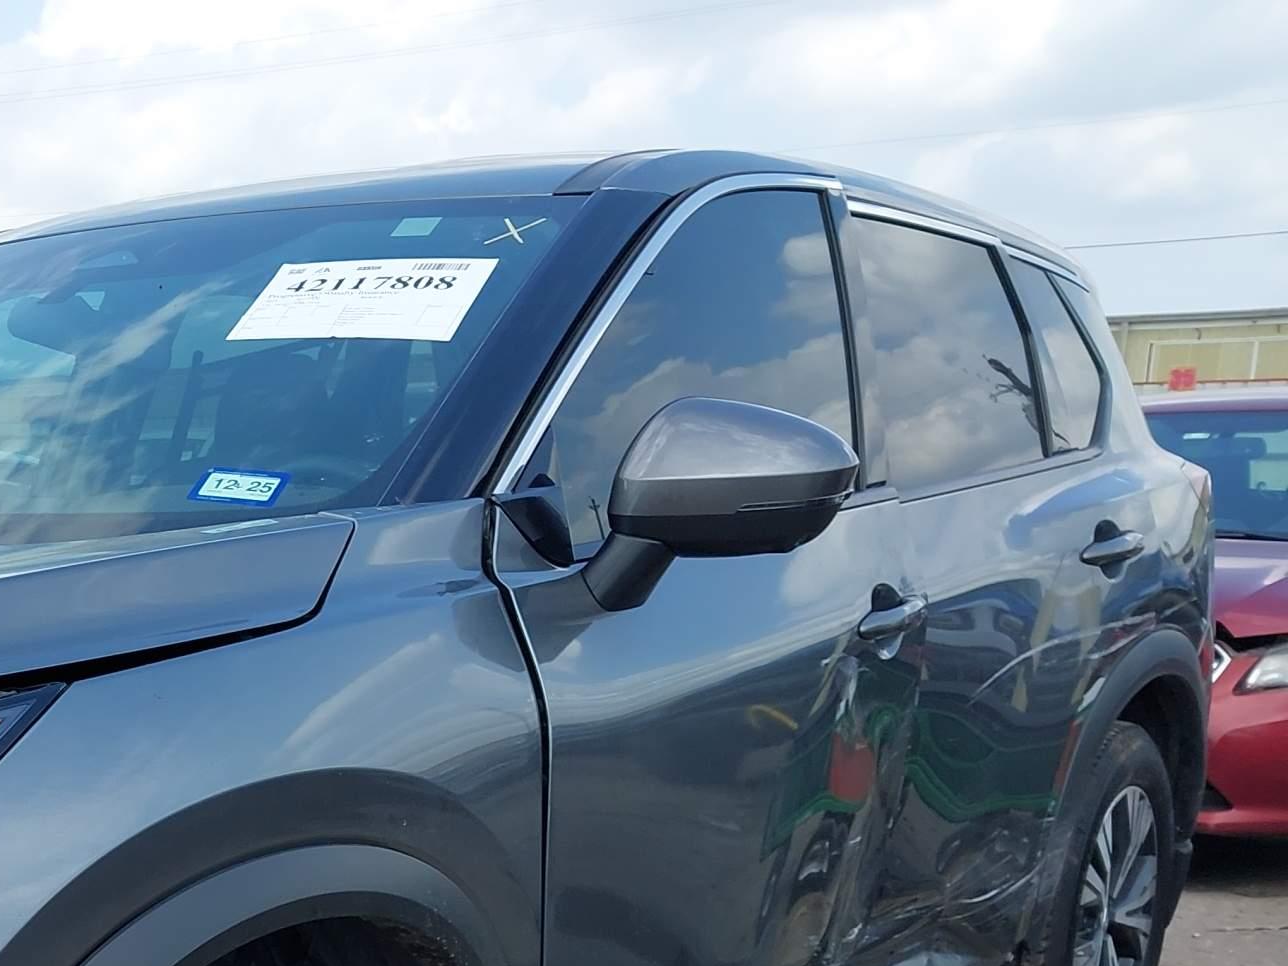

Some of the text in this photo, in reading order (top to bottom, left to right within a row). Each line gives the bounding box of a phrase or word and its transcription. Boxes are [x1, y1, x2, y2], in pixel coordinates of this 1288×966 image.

[285, 275, 458, 292] 42117808
[213, 478, 275, 494] 12 25
